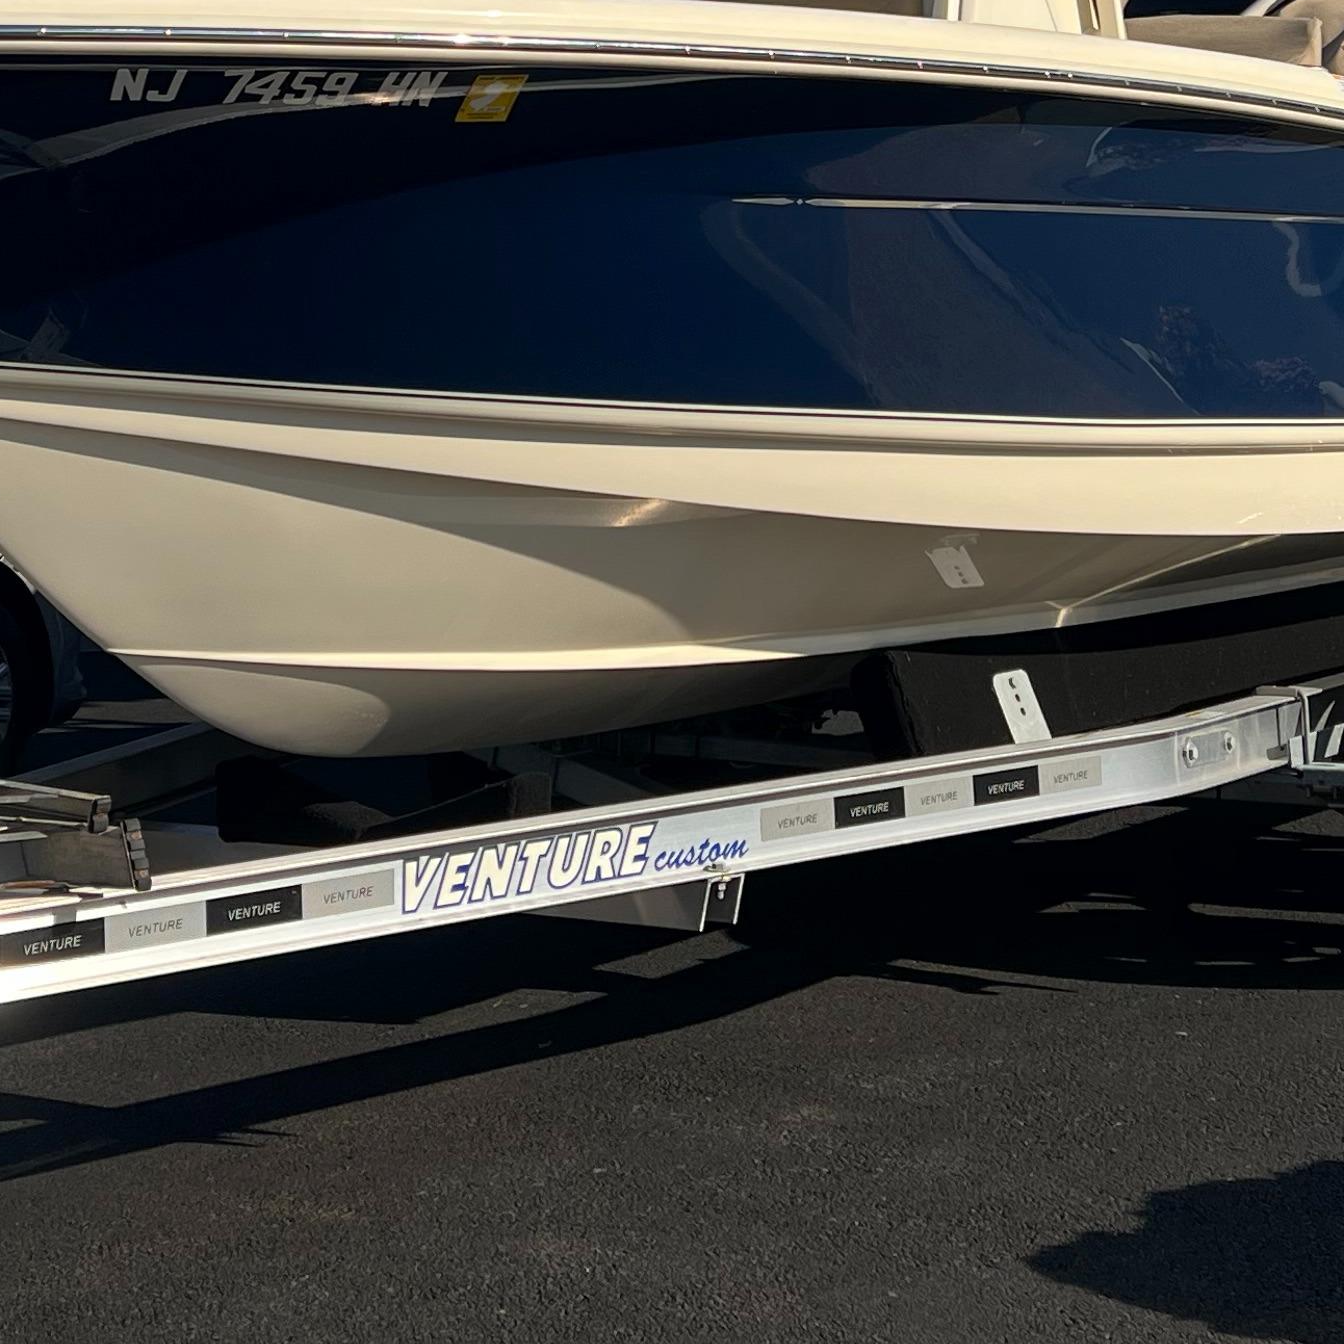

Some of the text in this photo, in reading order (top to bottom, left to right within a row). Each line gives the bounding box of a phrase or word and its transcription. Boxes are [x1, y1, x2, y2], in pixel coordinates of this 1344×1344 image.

[110, 68, 448, 107] NJ 7459 HN
[1053, 768, 1088, 784] VENTURE
[987, 779, 1025, 795] VENTURE
[920, 790, 958, 806] VENTURE
[849, 801, 889, 818] VENTURE
[777, 813, 818, 830] VENTURE
[402, 821, 749, 914] VENTURE custom
[323, 885, 375, 905] VENTURE
[227, 901, 282, 921] VENTURE
[128, 918, 184, 938] VENTURE
[23, 935, 83, 956] VENTURE
